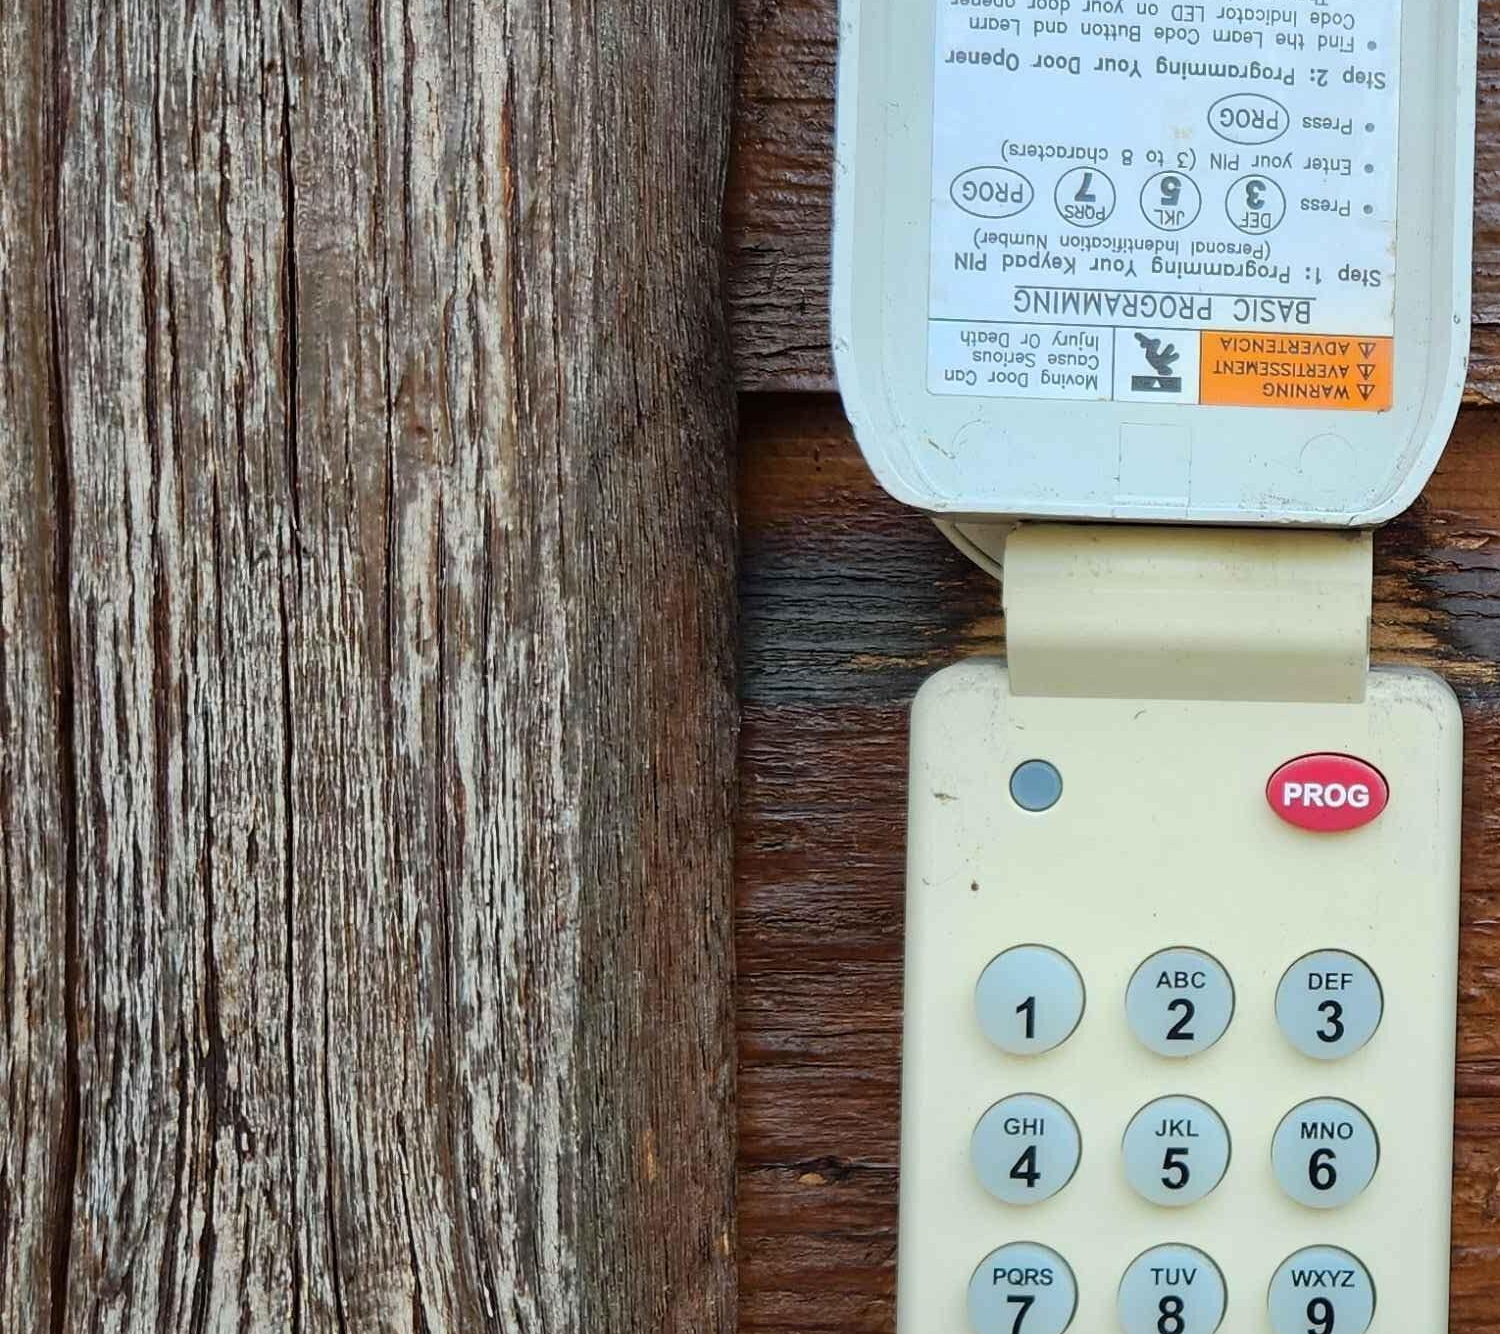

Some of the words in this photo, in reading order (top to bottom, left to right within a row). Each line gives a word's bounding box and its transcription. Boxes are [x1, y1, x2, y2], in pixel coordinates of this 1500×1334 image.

[1136, 2, 1160, 17] on
[1170, 3, 1206, 24] LED
[1215, 6, 1298, 29] Indicator
[968, 16, 1022, 37] Learn
[1033, 19, 1069, 39] and
[1309, 11, 1357, 32] Code
[1080, 21, 1142, 44] Button
[1153, 26, 1201, 47] Code
[1212, 28, 1264, 51] Learn
[1275, 32, 1306, 52] the
[1317, 34, 1356, 55] Find
[944, 47, 1021, 73] Opener
[1029, 53, 1082, 76] Door
[1093, 56, 1143, 80] Your
[1155, 55, 1296, 87] Programming
[1309, 67, 1330, 89] 2:
[1342, 64, 1387, 91] Step
[1220, 108, 1279, 130] PROG
[1301, 116, 1354, 137] Press
[1000, 138, 1110, 166] characters)
[1120, 148, 1135, 167] 8
[1145, 149, 1165, 169] to
[1176, 147, 1198, 173] (3
[1209, 152, 1241, 172] PIN
[1250, 151, 1294, 170] your
[1303, 156, 1353, 177] Enter
[962, 181, 1024, 204] PROG
[1074, 173, 1096, 202] 7
[1161, 177, 1182, 205] 5
[1246, 180, 1266, 210] 3
[1064, 204, 1105, 219] PQRS
[1154, 209, 1184, 225] JKL
[1299, 197, 1352, 218] Press
[1239, 212, 1271, 228] DEF
[973, 227, 1049, 251] Number)
[1059, 234, 1180, 257] Indentification
[1190, 239, 1272, 263] (Personal
[954, 251, 988, 273] PIN
[1001, 250, 1077, 277] Keypad
[1088, 256, 1139, 279] Your
[1151, 255, 1292, 285] Programming
[1305, 266, 1323, 286] 1:
[1337, 262, 1383, 289] Step
[1013, 289, 1212, 321] PROGRAMMING
[1233, 299, 1311, 325] BASIC
[960, 330, 1011, 350] Death
[1019, 332, 1042, 350] Or
[1051, 330, 1100, 353] Injury
[1219, 336, 1352, 357] ADVERTENCIA
[971, 349, 1037, 370] Serious
[1047, 352, 1101, 372] Cause
[1212, 359, 1351, 380] AVERTISSEMENT
[944, 368, 979, 387] Can
[986, 370, 1030, 389] Door
[1040, 368, 1099, 392] Moving
[1262, 382, 1351, 401] WARNING
[1283, 782, 1370, 808] PROG
[1155, 970, 1206, 990] ABC
[1308, 972, 1354, 991] DEF
[1015, 995, 1036, 1040] 1
[1165, 997, 1196, 1041] 2
[1315, 999, 1345, 1044] 3
[1003, 1117, 1045, 1136] GHI
[1154, 1118, 1200, 1138] JKL
[1300, 1121, 1354, 1141] MNO
[1009, 1144, 1042, 1189] 4
[1160, 1146, 1191, 1191] 5
[1308, 1147, 1337, 1191] 6
[992, 1267, 1054, 1287] PQRS
[1149, 1267, 1198, 1286] TUV
[1291, 1269, 1356, 1288] WXYZ
